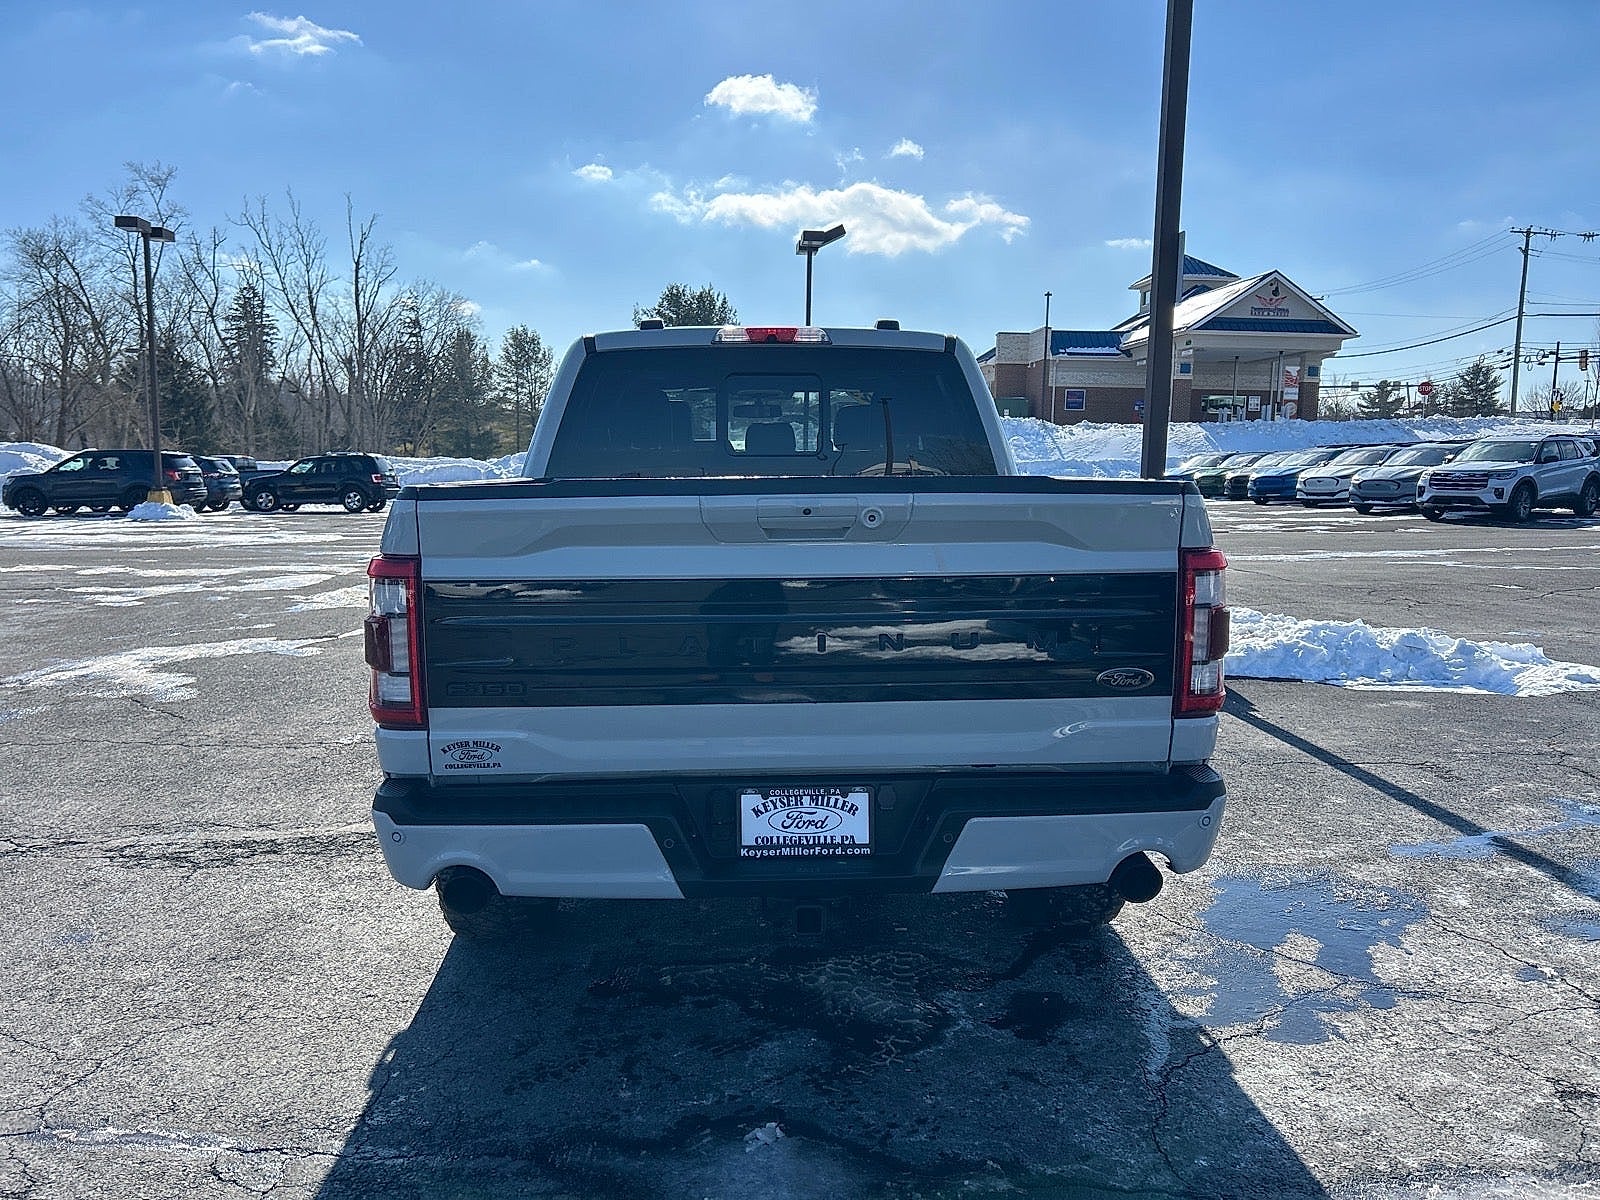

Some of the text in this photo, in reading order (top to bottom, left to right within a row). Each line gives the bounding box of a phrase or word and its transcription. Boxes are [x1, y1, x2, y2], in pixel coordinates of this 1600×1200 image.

[552, 632, 1059, 652] PLATINUM
[1110, 672, 1142, 685] Ford
[441, 741, 502, 754] KEYSER MILLER
[459, 750, 485, 760] Ford
[751, 796, 860, 818] KEYSER MILLER
[781, 810, 830, 829] Ford
[740, 847, 871, 858] KeyserMillerFord.com
